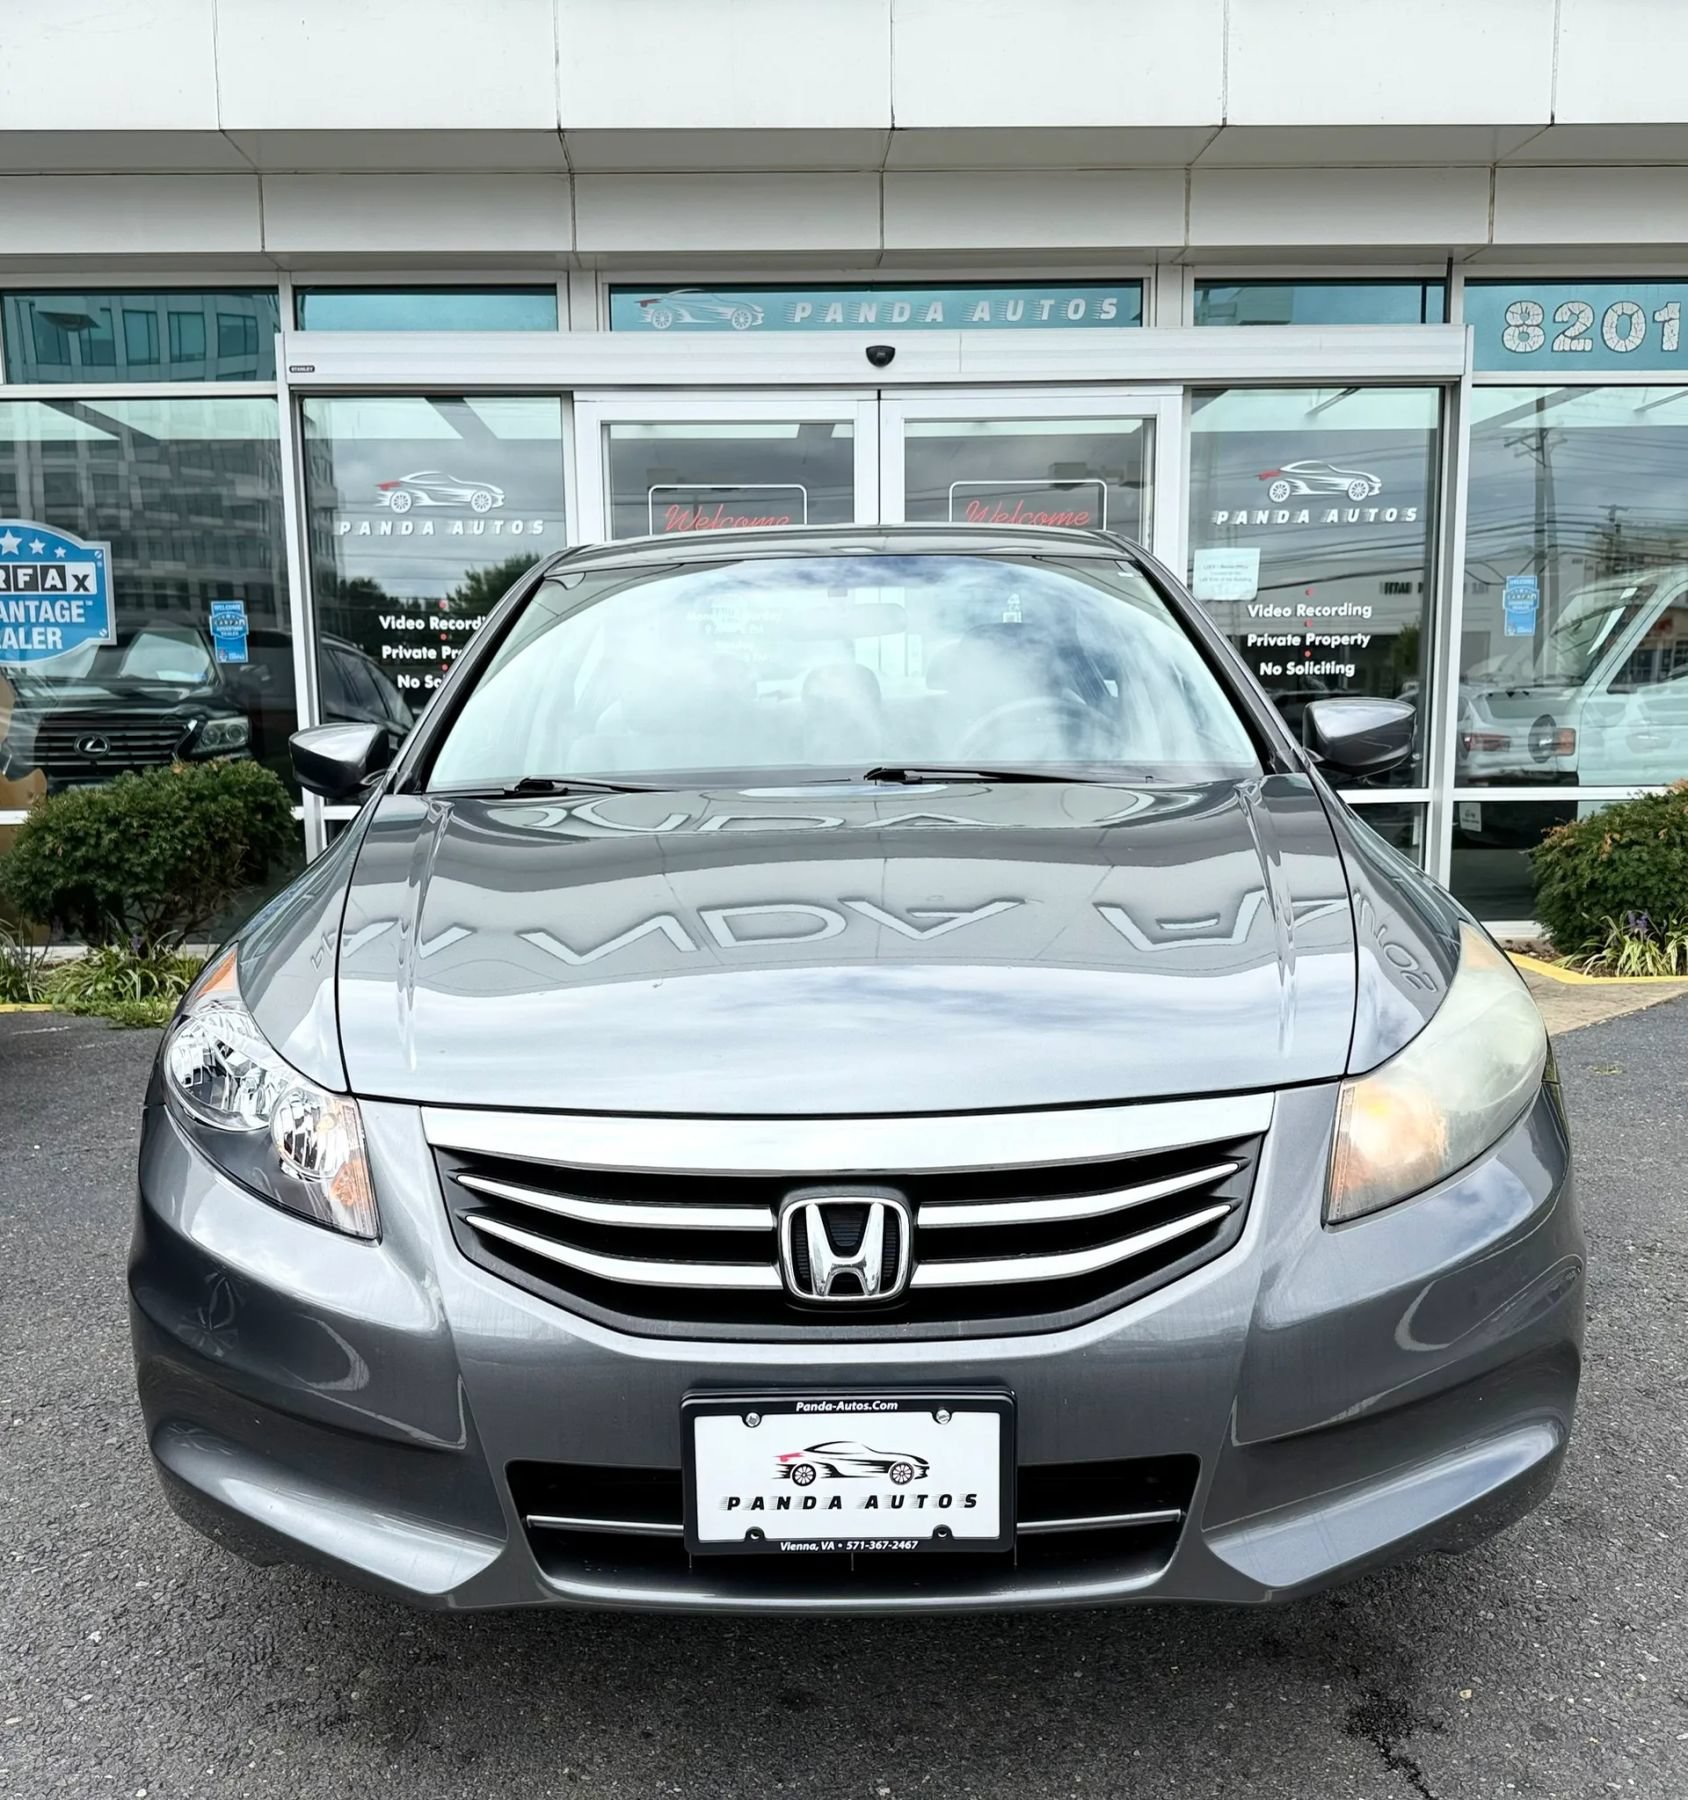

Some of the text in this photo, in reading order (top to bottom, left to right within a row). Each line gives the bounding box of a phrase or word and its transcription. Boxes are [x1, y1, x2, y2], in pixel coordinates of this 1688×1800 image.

[793, 298, 1118, 324] PANDA AUTOS
[1502, 300, 1682, 353] 8201
[665, 503, 790, 531] Welcome
[965, 499, 1090, 527] Welcome
[1216, 507, 1418, 525] PANDA AUTOS
[339, 519, 544, 536] PANDA AUTOS
[1248, 602, 1373, 619] Video Recording
[379, 615, 486, 630] Video Record
[0, 627, 63, 650] ALER
[1247, 632, 1371, 648] Private Property
[382, 645, 437, 659] Private
[1259, 660, 1356, 677] No Soliciting
[397, 674, 446, 688] No So
[796, 1400, 898, 1412] Panda-Autos.Com
[727, 1493, 978, 1511] PANDA AUTOS
[780, 1540, 919, 1551] Vienna, VA 571-367-2467
